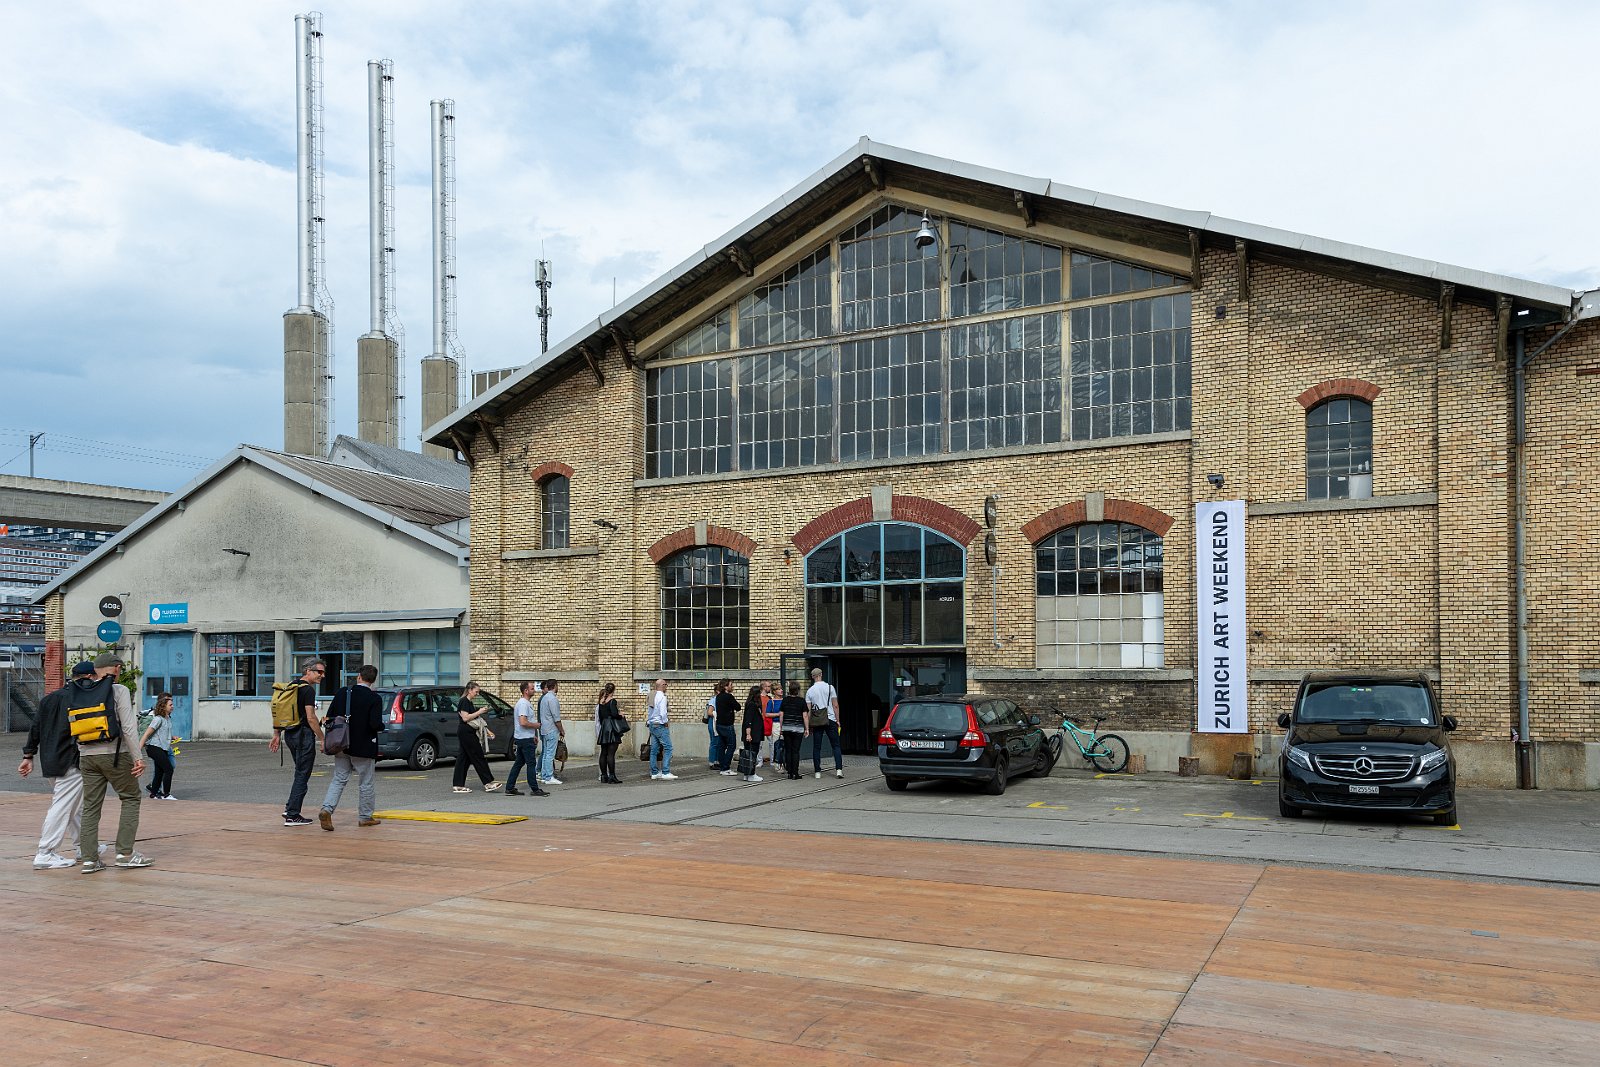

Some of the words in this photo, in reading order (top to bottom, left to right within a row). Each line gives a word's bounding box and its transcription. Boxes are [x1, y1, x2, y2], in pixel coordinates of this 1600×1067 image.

[1212, 510, 1229, 605] WEEKEND
[1213, 611, 1229, 649] ART
[1214, 656, 1231, 729] ZURICH
